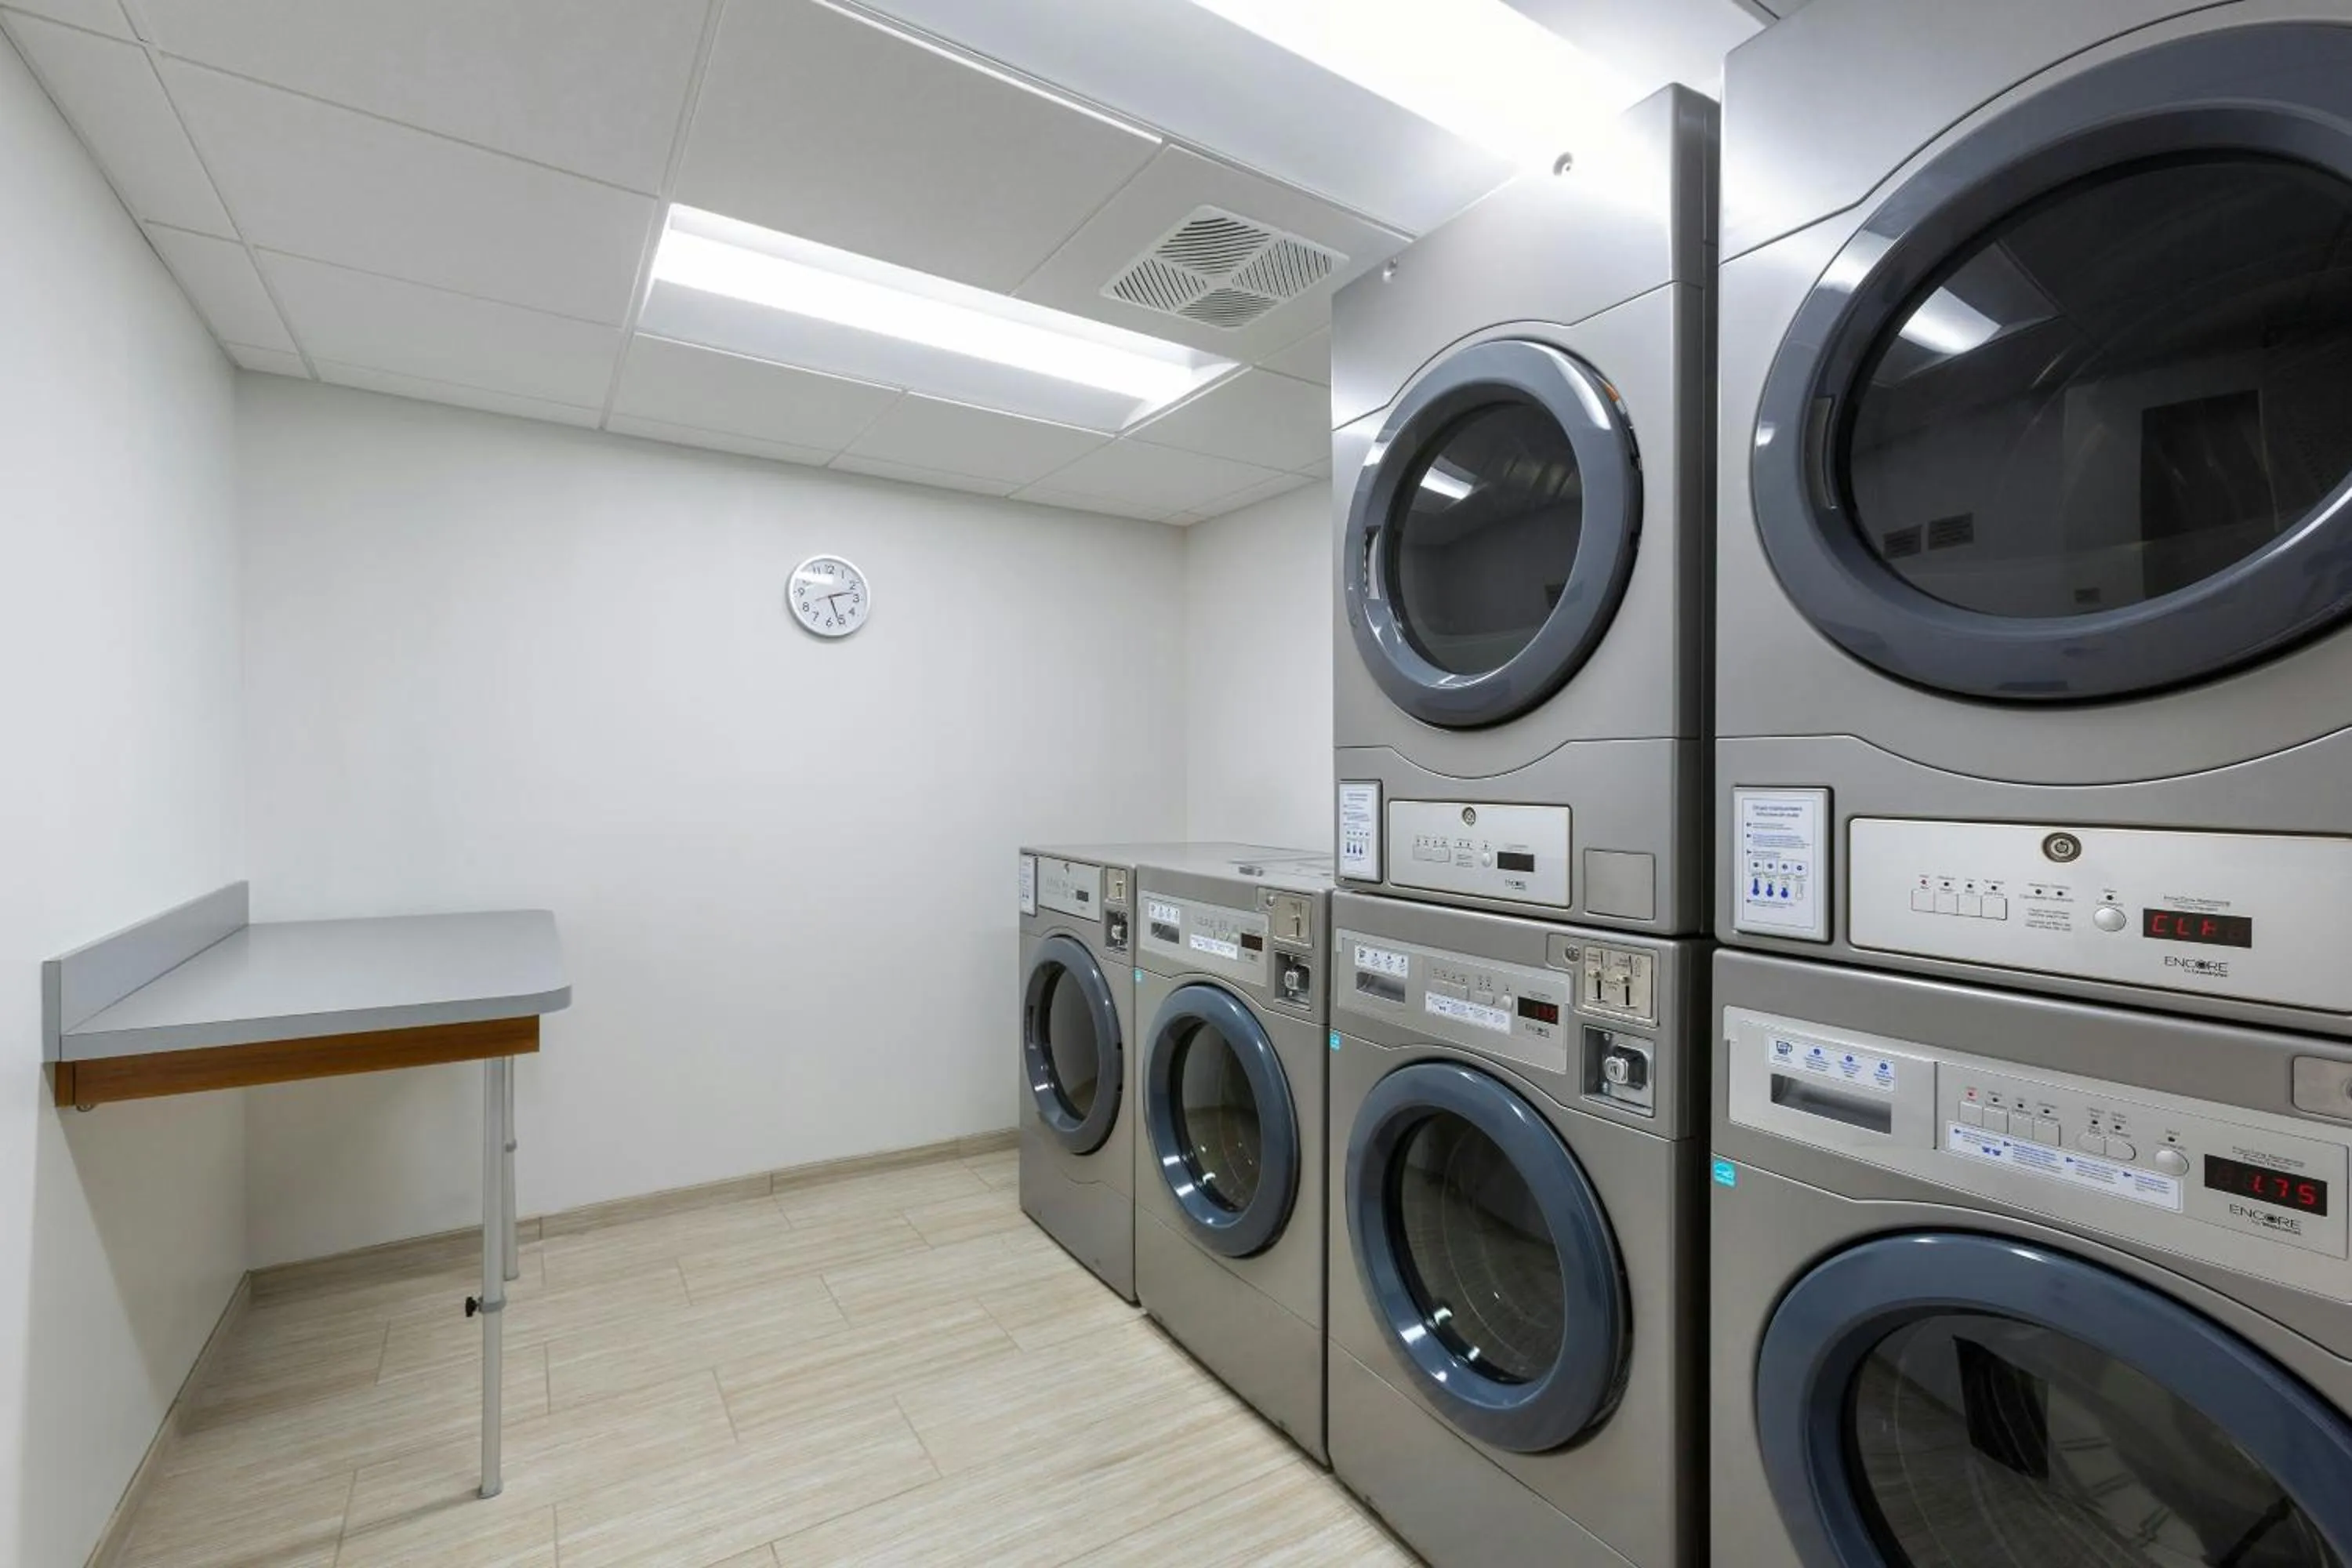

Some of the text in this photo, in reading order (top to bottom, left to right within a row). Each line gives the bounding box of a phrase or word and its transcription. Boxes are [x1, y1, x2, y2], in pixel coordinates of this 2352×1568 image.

[825, 564, 835, 575] 12
[849, 580, 856, 590] 2
[797, 588, 805, 597] 9
[853, 593, 860, 603] 3
[803, 601, 810, 612] 8
[848, 608, 855, 616] 4
[812, 611, 820, 622] 7
[826, 617, 833, 627] 6
[837, 614, 846, 625] 5
[2164, 955, 2229, 973] ENCORE
[2228, 1203, 2303, 1229] ENCORE
